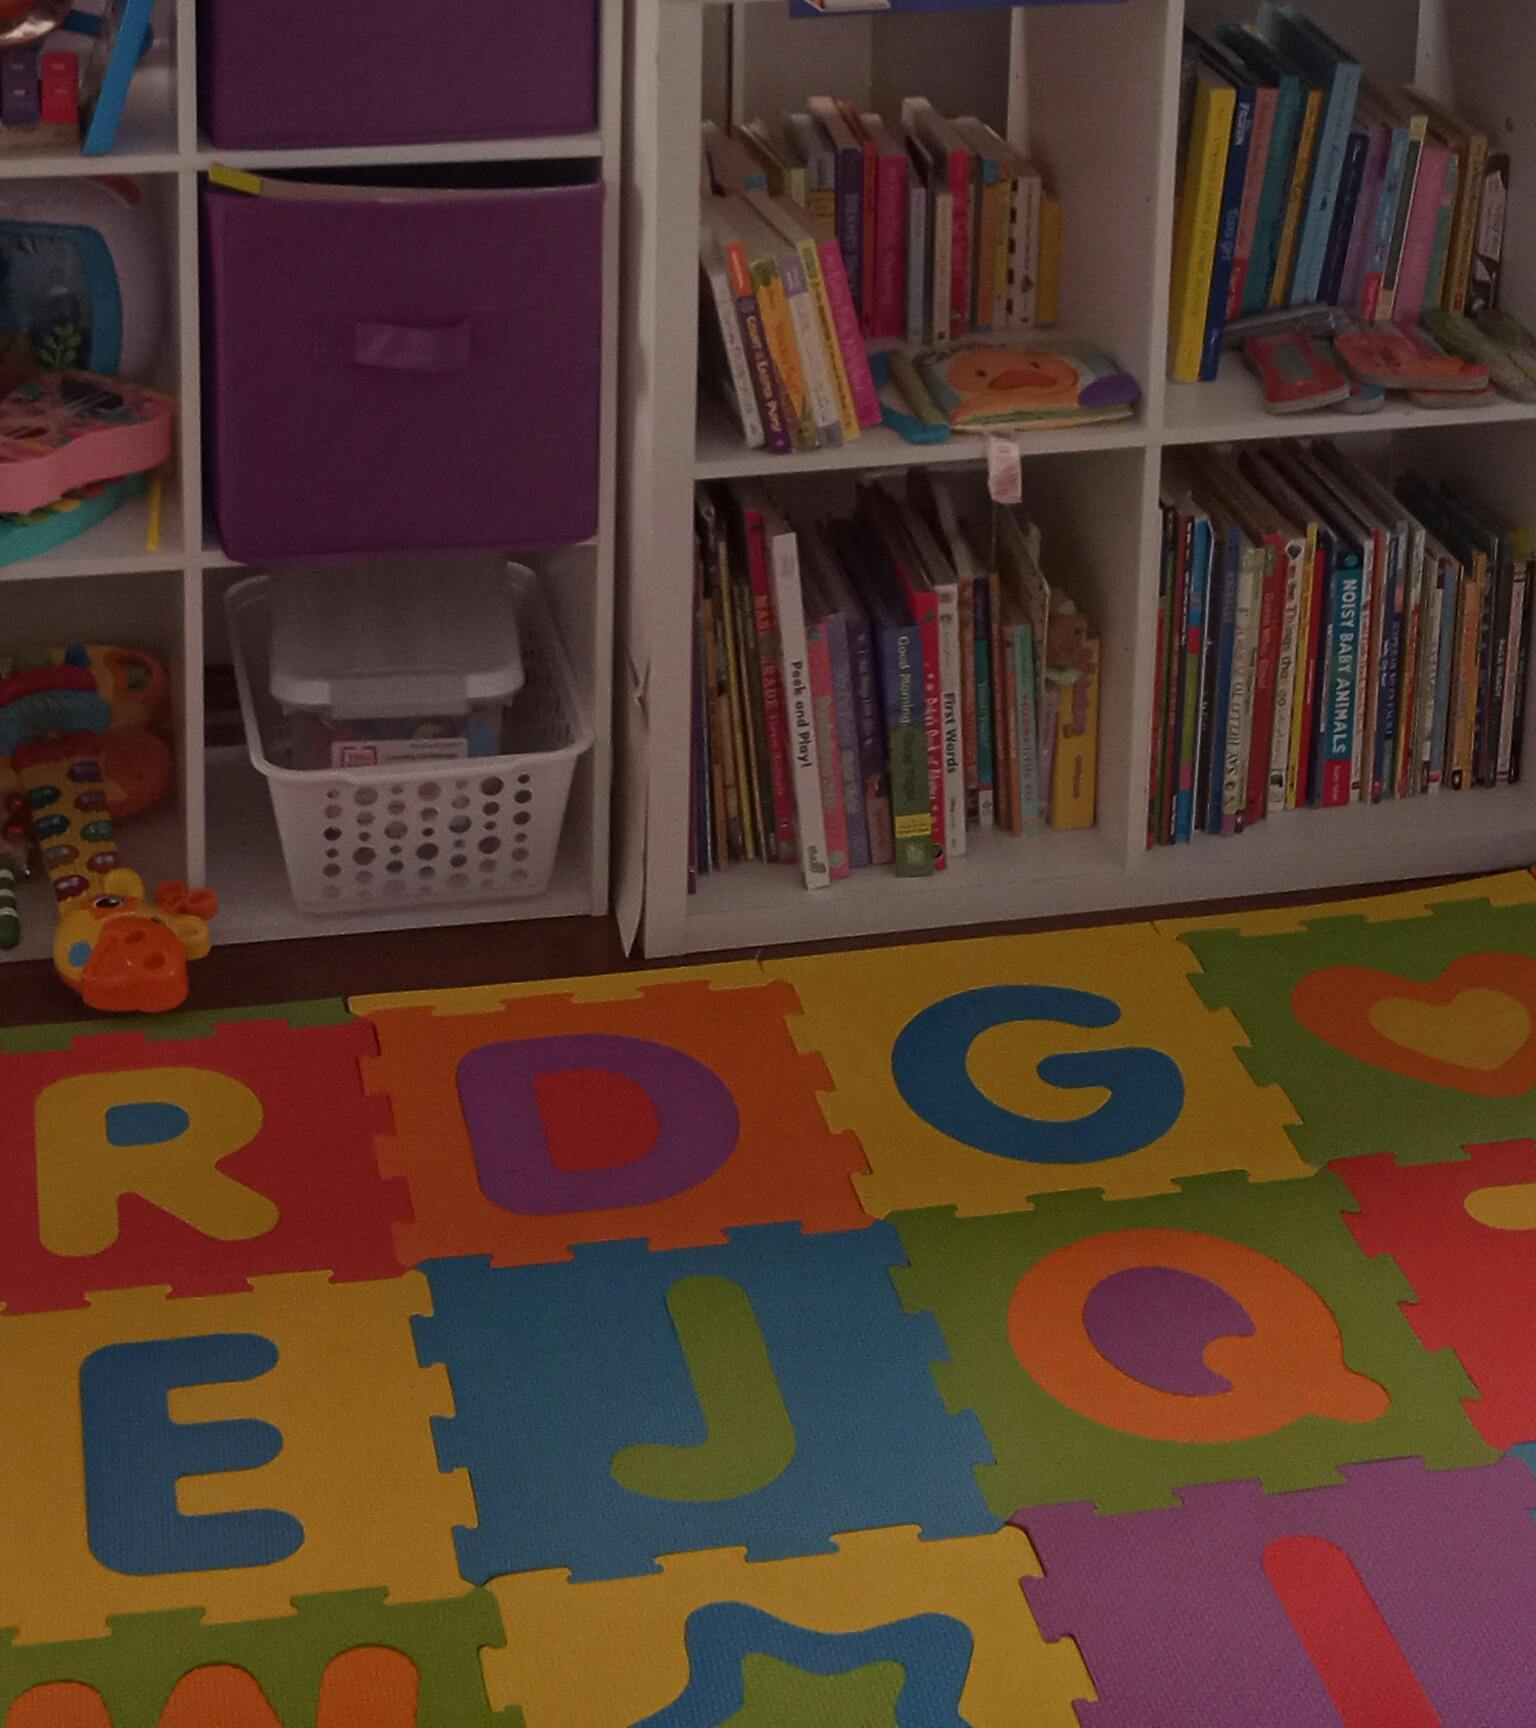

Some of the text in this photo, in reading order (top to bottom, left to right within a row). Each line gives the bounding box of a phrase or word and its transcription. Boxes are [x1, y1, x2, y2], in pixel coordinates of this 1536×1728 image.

[896, 635, 910, 669] Good
[1336, 631, 1353, 672] BABY
[1339, 578, 1357, 627] NOISY
[789, 660, 811, 768] Peek and Play!
[943, 692, 957, 773] First Words
[1331, 677, 1350, 754] ANIMALS
[456, 1032, 740, 1216] D
[892, 984, 1185, 1165] G
[35, 1068, 278, 1256] R
[610, 1275, 796, 1502] J
[1008, 1226, 1391, 1443] Q
[79, 1333, 305, 1576] E
